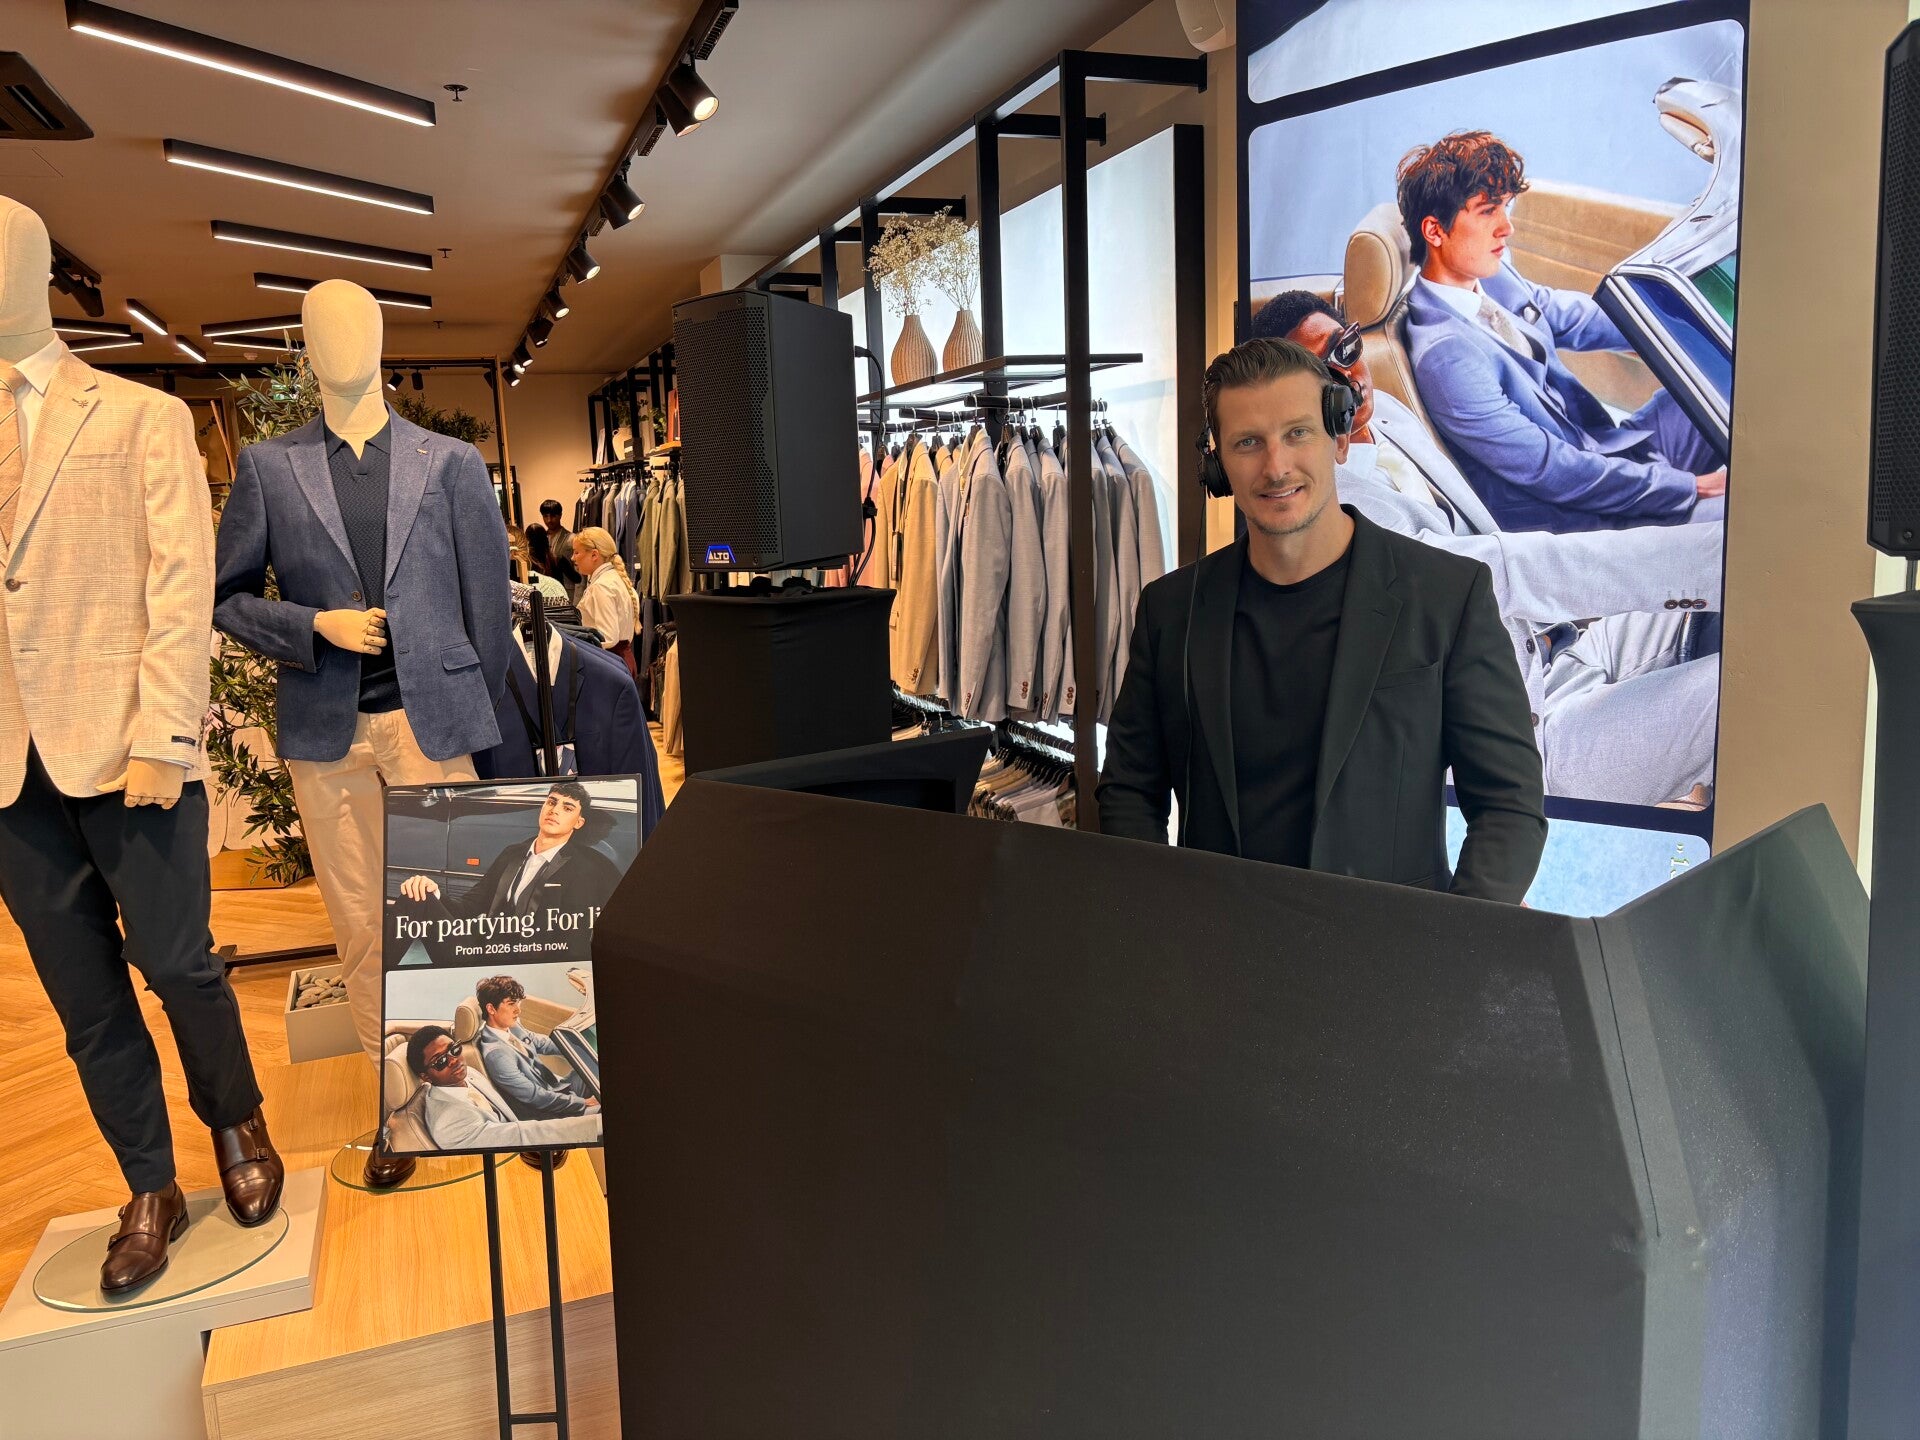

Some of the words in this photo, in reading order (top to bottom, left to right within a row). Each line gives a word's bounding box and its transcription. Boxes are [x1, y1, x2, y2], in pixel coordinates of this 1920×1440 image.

[708, 551, 730, 560] ALTO
[395, 915, 433, 939] For
[437, 911, 541, 942] partying.
[546, 908, 584, 931] For
[455, 944, 483, 956] Prom
[485, 943, 511, 955] 2026
[513, 942, 543, 953] starts
[544, 942, 569, 952] now.
